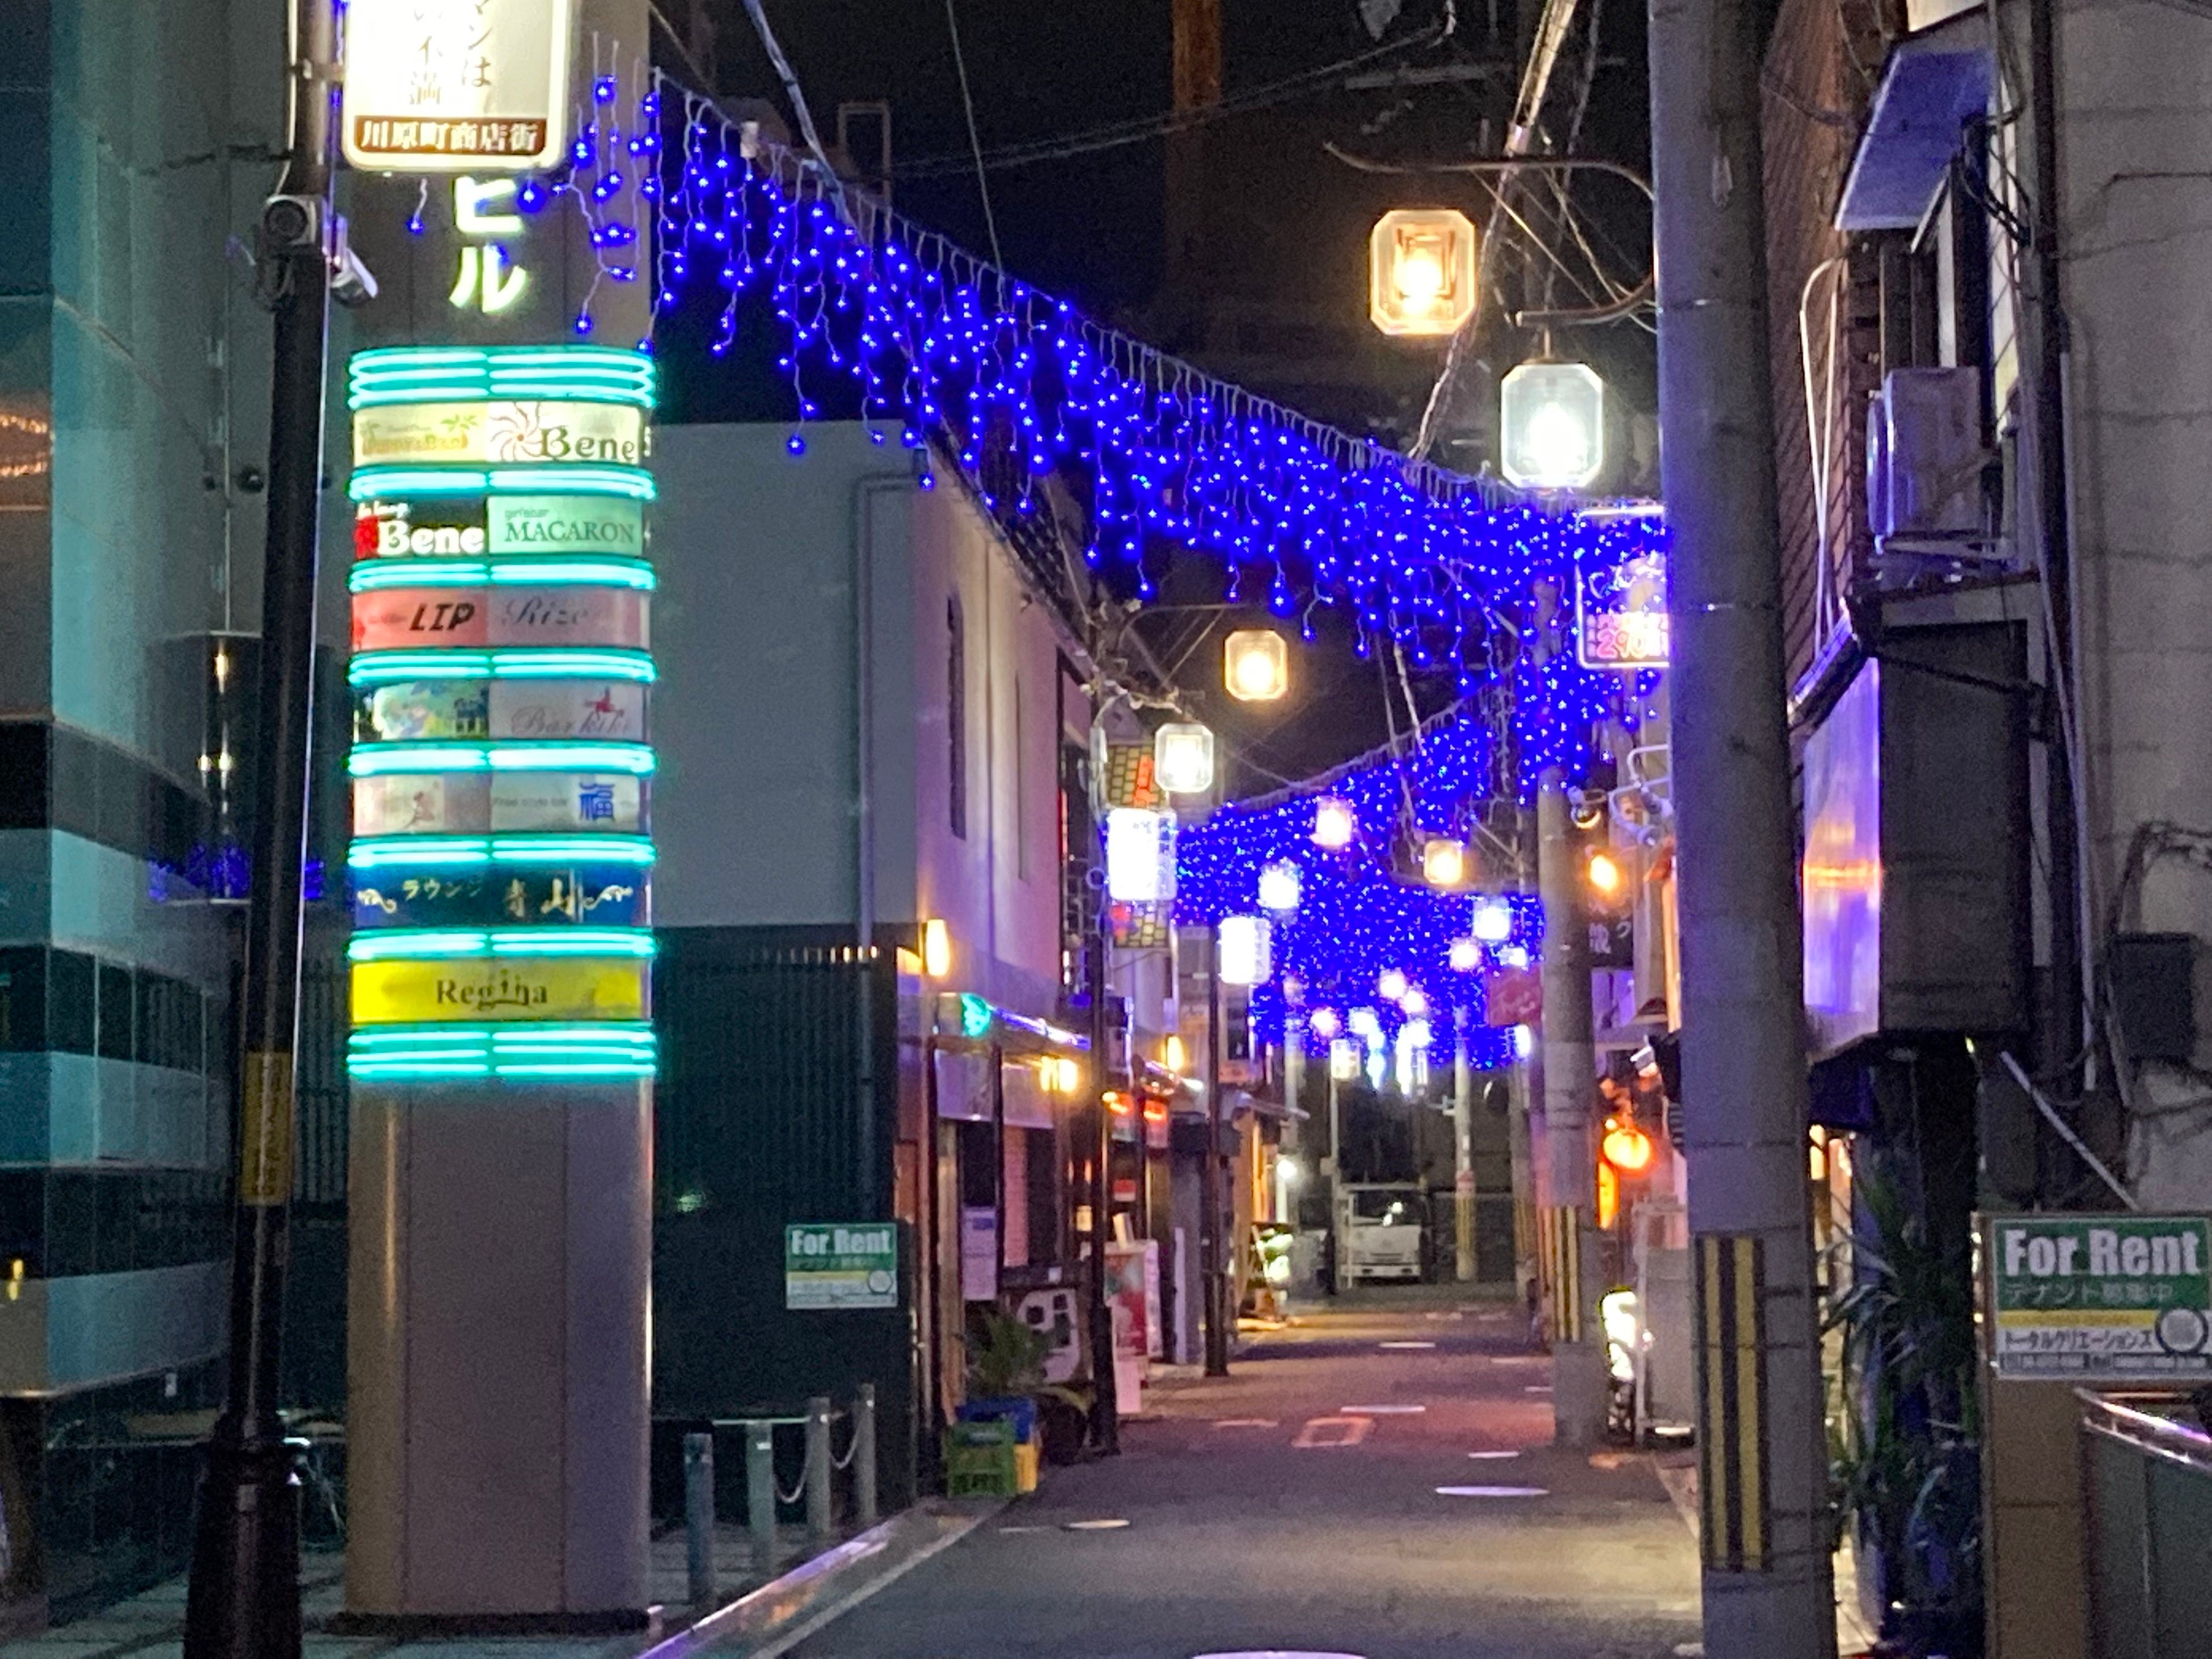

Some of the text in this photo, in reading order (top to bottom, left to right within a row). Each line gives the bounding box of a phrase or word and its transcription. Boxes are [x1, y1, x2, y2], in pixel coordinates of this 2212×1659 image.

[361, 120, 538, 151] 川原町商店街
[539, 425, 635, 462] Bene
[377, 520, 485, 555] Bene
[504, 521, 634, 543] MACARON
[409, 603, 475, 631] LIP
[436, 969, 548, 1011] Regina
[792, 1229, 891, 1255] For Rent
[2005, 1229, 2201, 1276] For Rent
